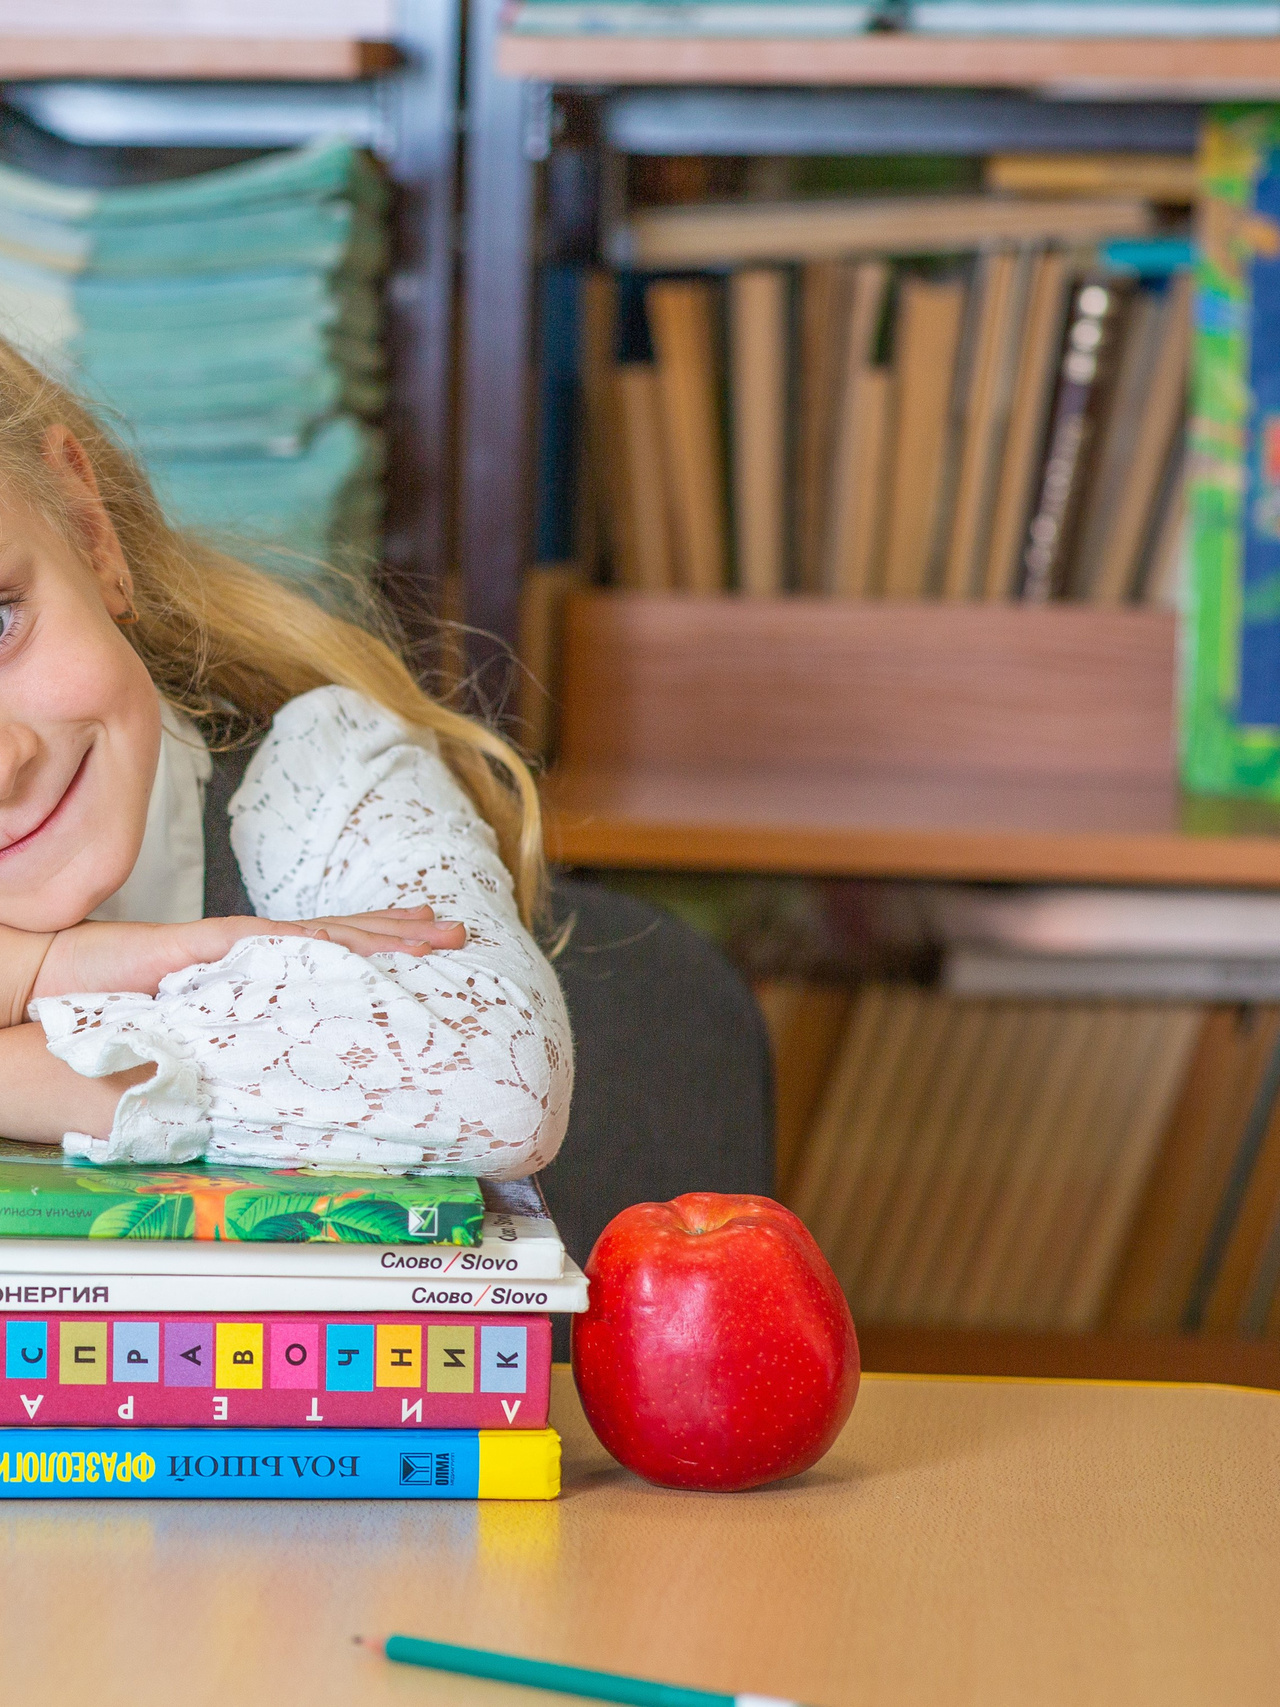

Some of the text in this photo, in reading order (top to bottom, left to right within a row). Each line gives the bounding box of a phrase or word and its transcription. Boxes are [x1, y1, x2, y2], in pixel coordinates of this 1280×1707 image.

[45, 1207, 92, 1219] МАРИНА
[166, 1455, 361, 1482] БОЛЬШОЙ
[434, 1453, 450, 1486] ОЛМА
